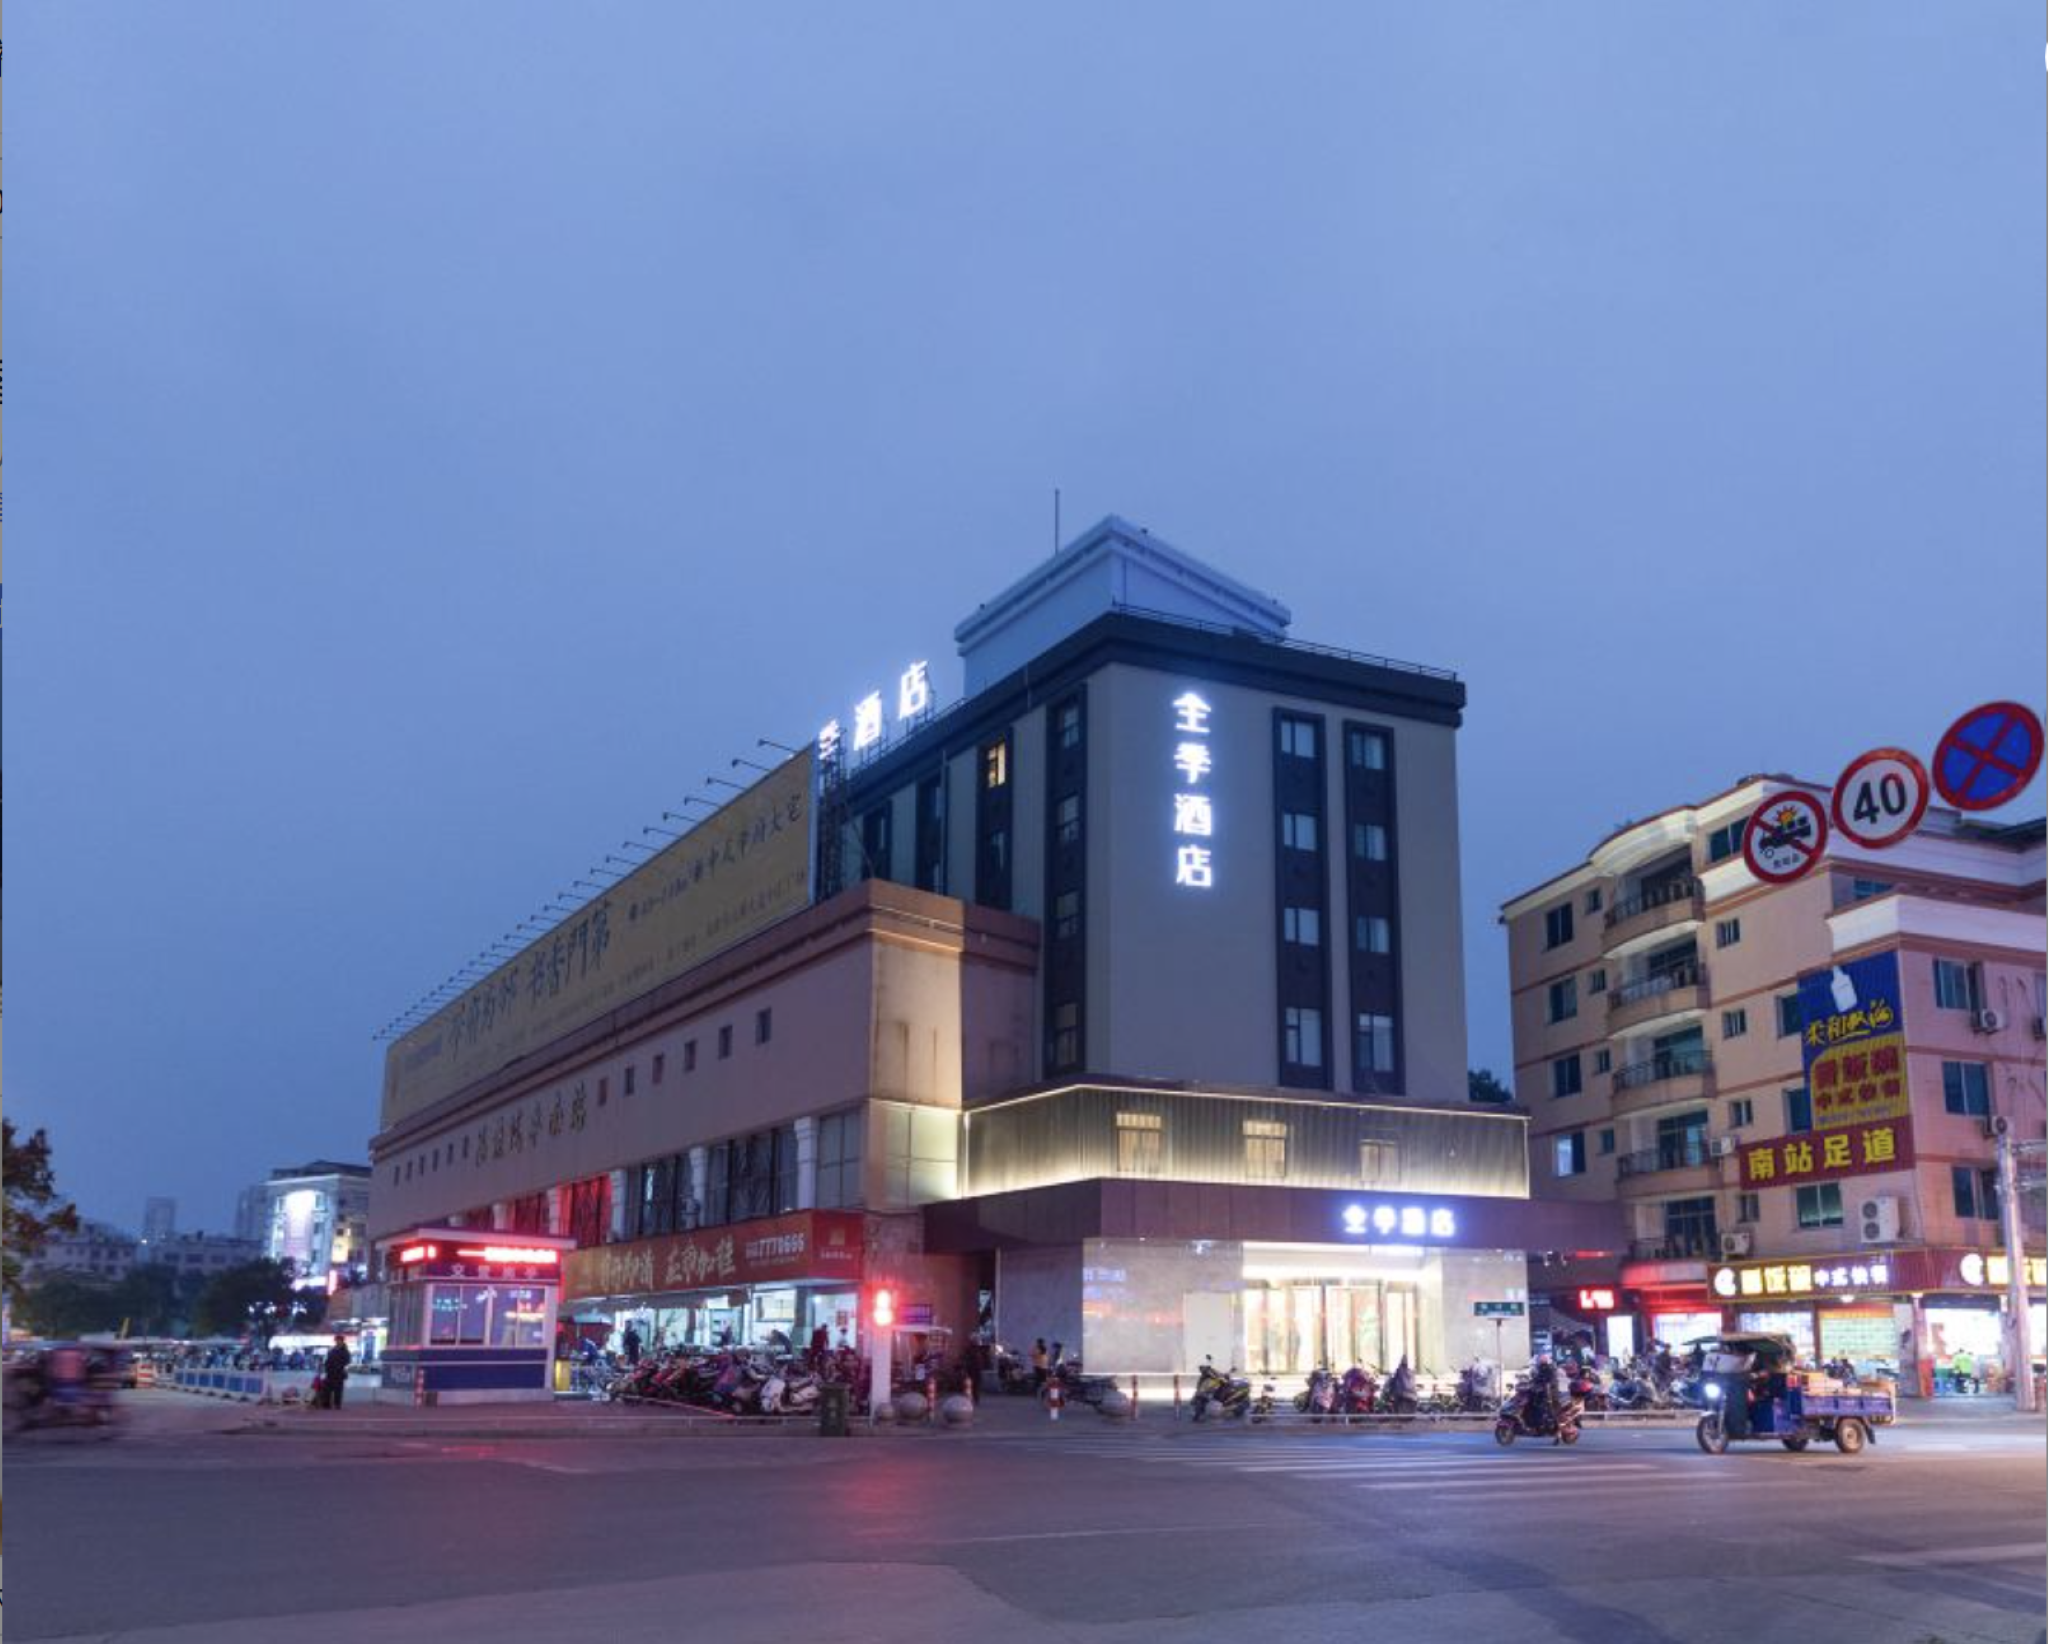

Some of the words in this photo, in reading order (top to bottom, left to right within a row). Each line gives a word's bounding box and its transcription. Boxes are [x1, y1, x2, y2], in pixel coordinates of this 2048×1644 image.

[1173, 692, 1212, 887] 全季酒店
[1853, 772, 1906, 825] 40
[1749, 1127, 1896, 1181] 南站足道
